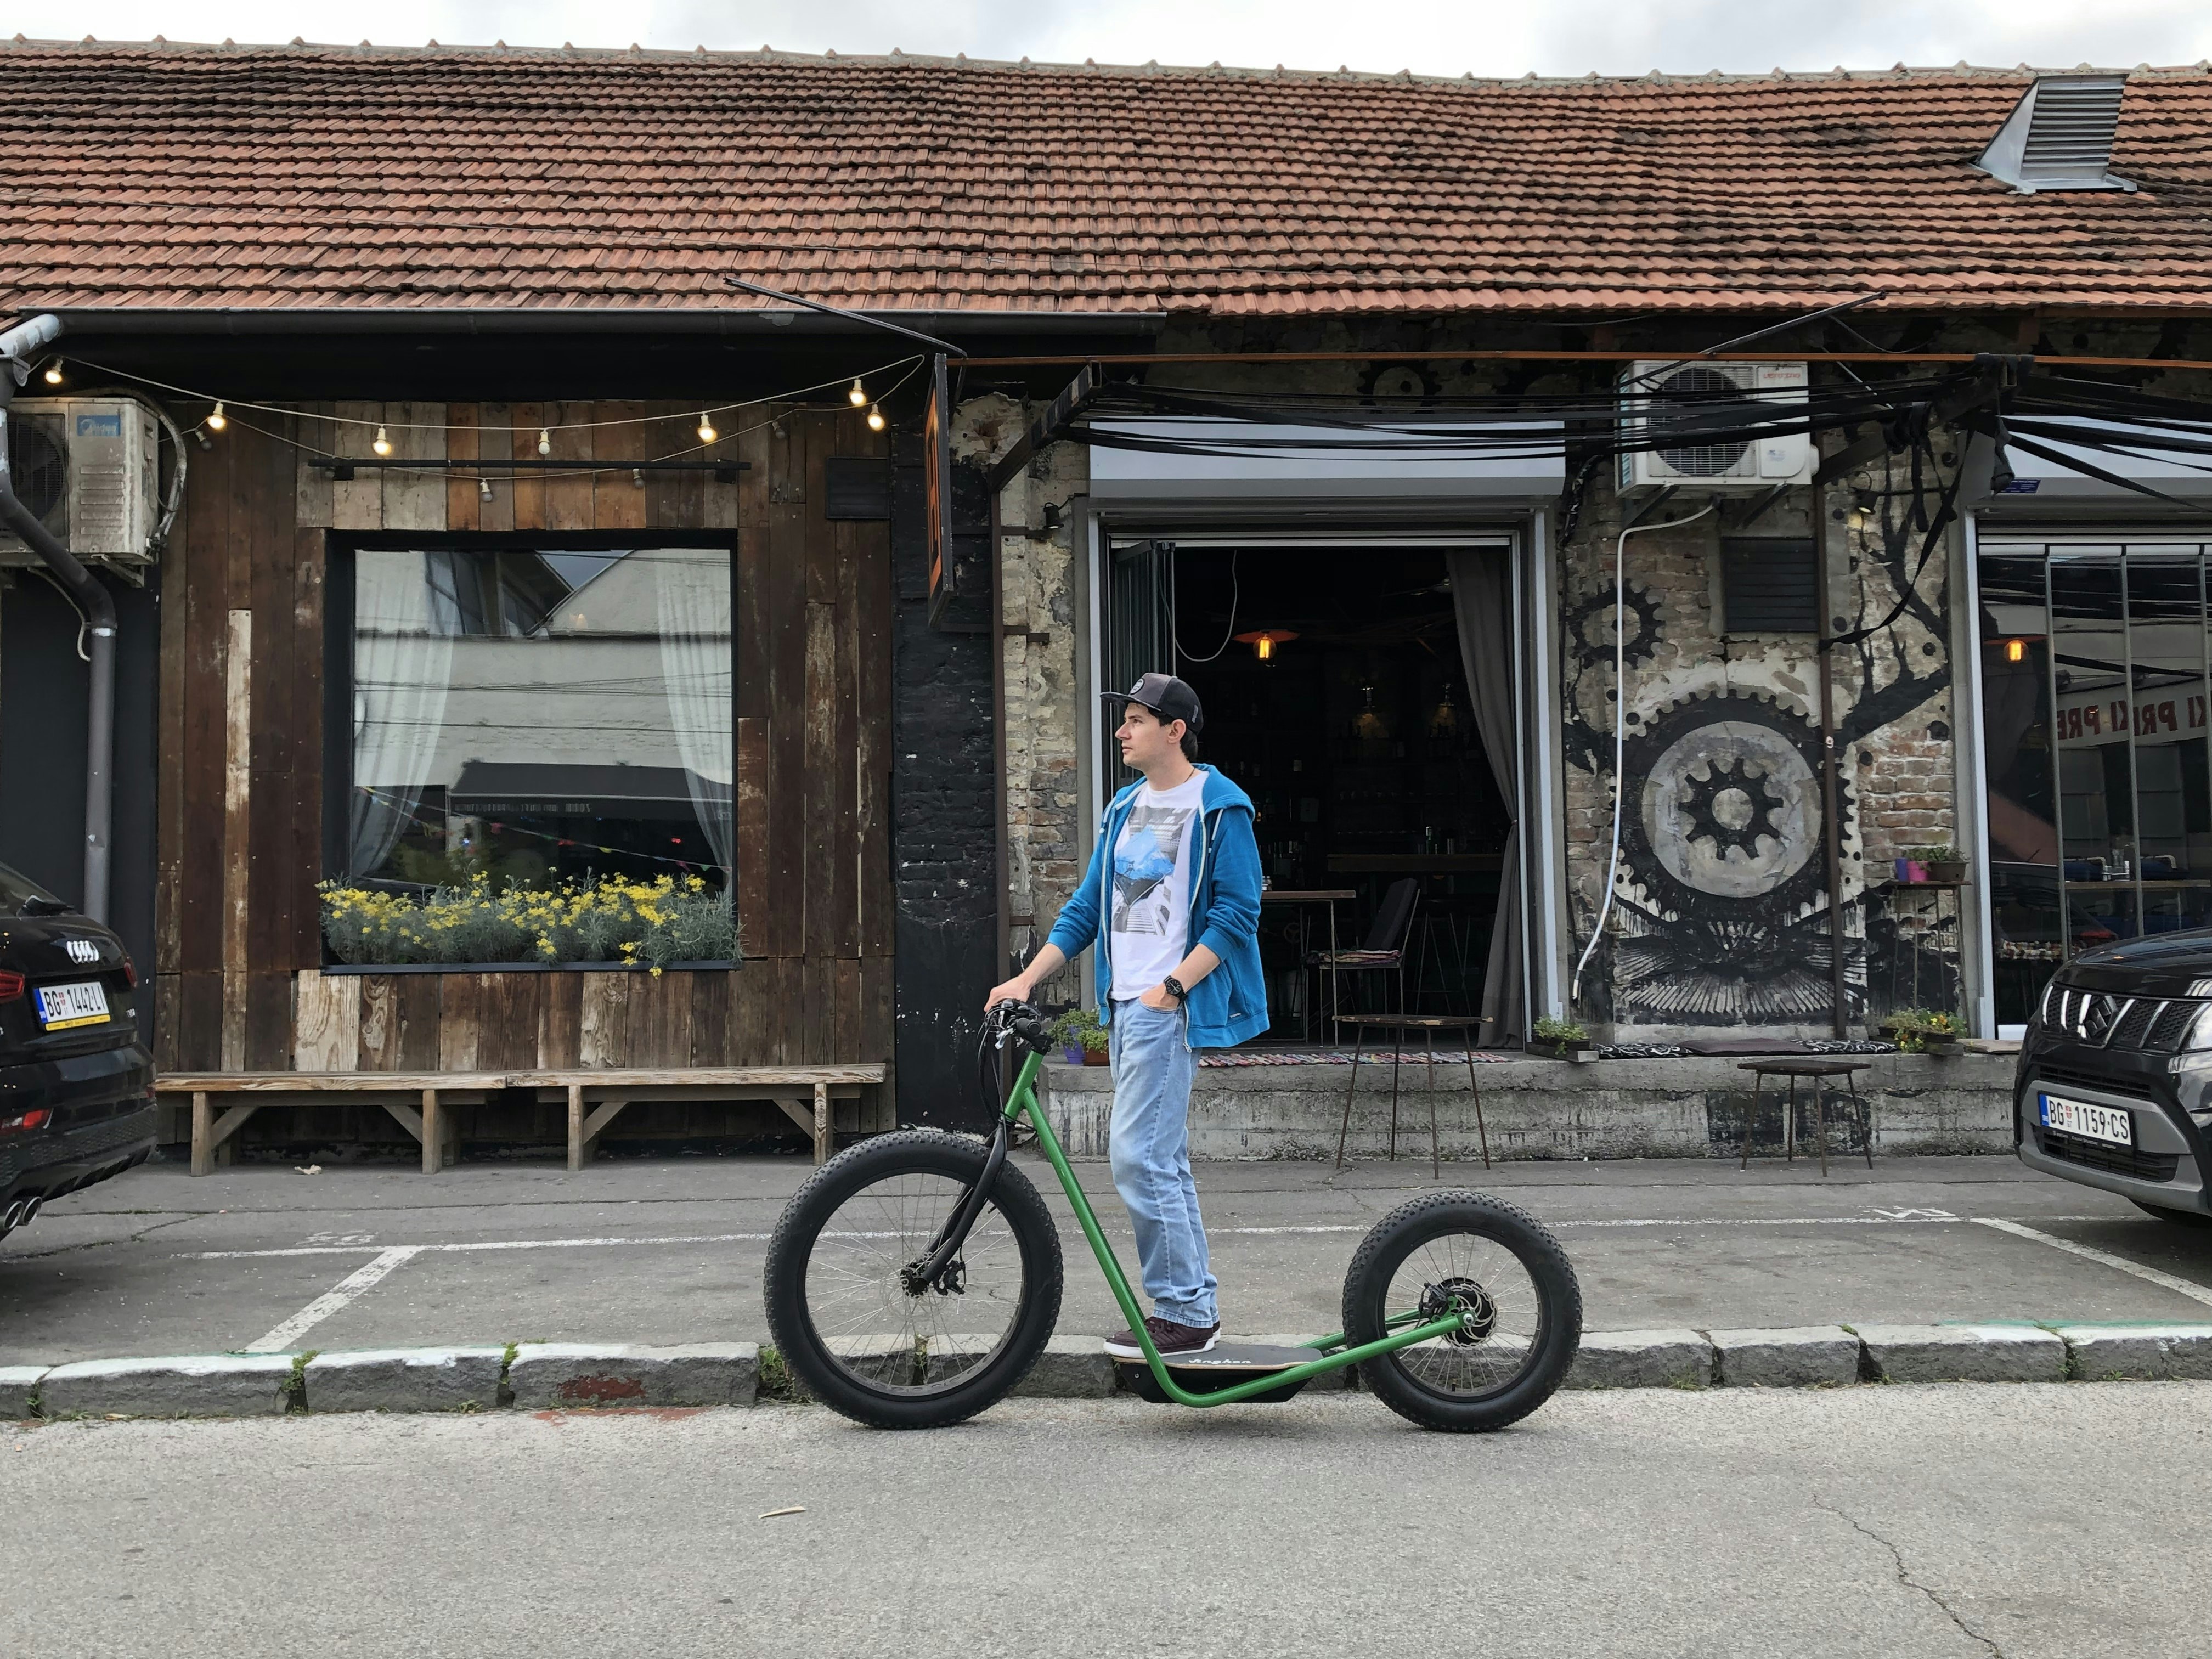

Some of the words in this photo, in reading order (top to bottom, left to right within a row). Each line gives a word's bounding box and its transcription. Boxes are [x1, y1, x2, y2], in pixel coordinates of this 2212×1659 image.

[43, 990, 62, 1017] BG
[2049, 1099, 2064, 1125] BG
[2075, 1105, 2129, 1140] 1159-CS
